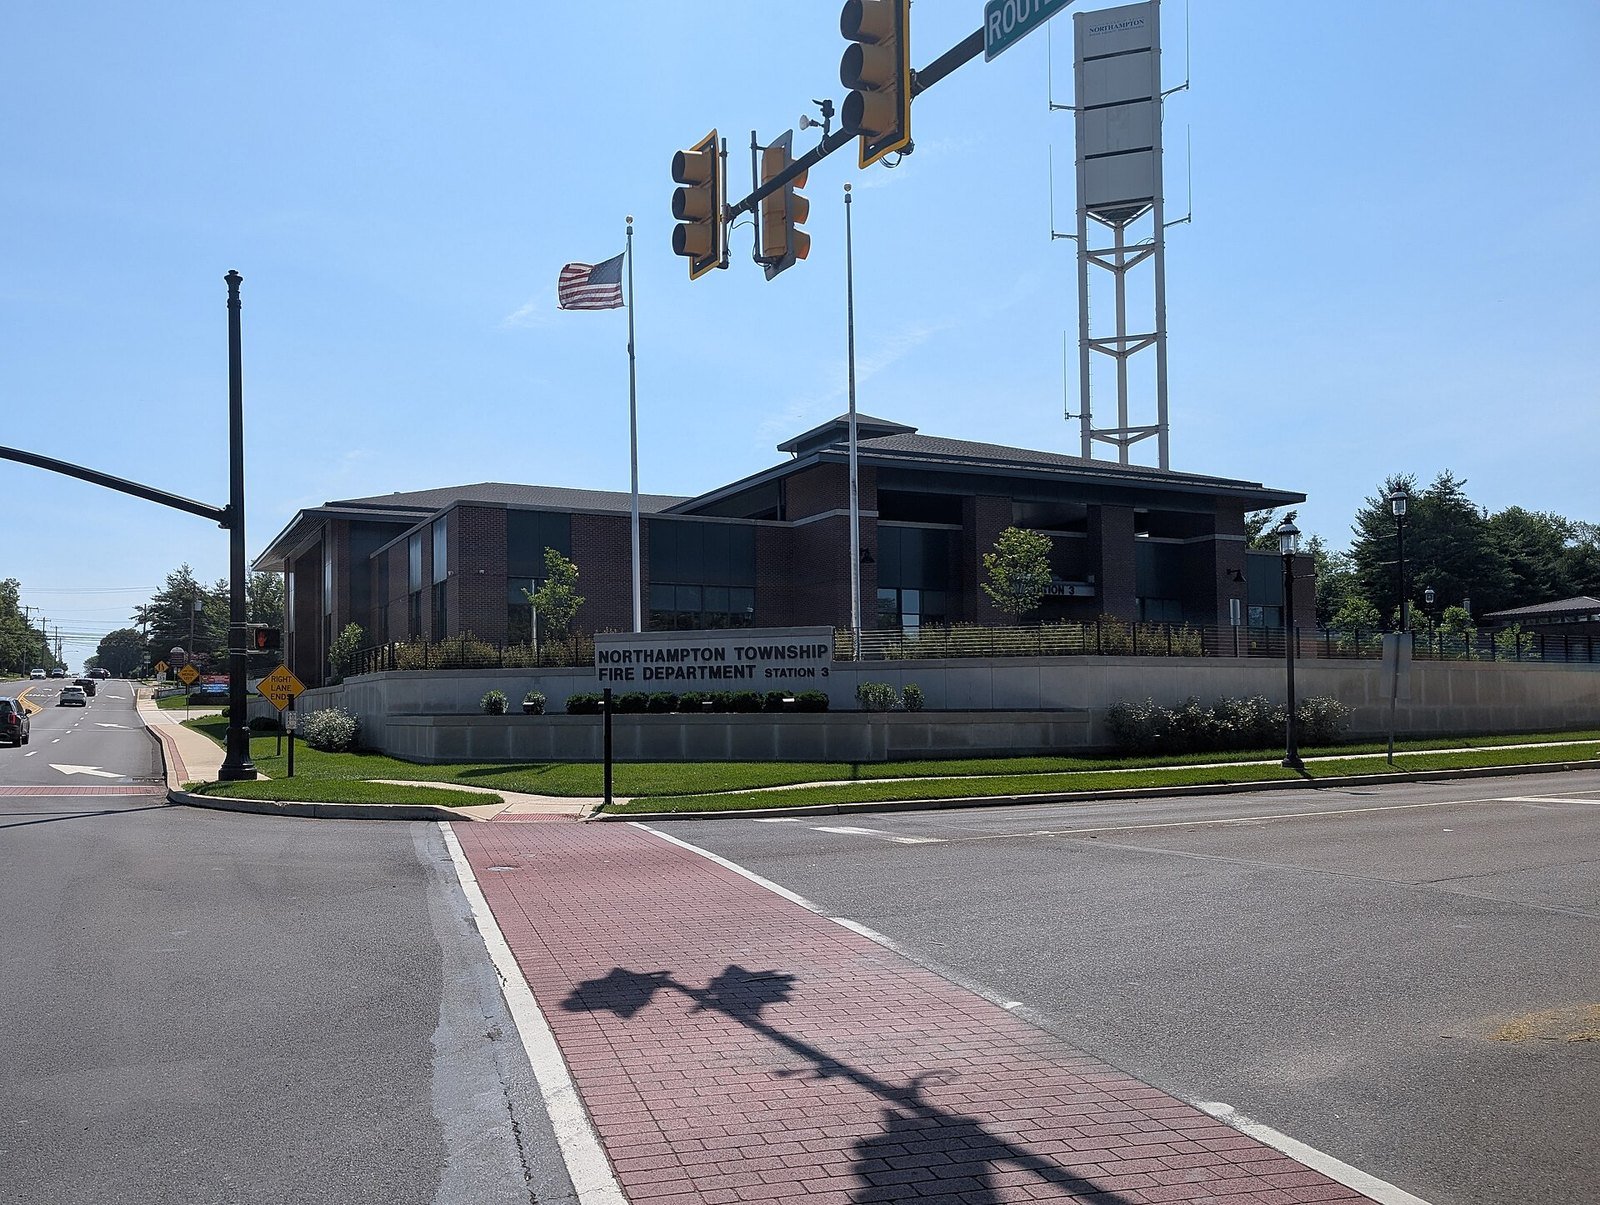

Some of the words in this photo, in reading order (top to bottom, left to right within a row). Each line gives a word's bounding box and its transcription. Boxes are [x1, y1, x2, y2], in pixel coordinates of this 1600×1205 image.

[989, 0, 1052, 47] ROU
[1089, 19, 1145, 33] NORTHAMPTON
[1069, 586, 1075, 595] 3
[598, 647, 726, 664] NORTHAMPTON
[734, 644, 828, 661] TOWNSHIP
[598, 667, 635, 681] FIRE
[643, 664, 756, 681] DEPARTMENT
[765, 667, 815, 679] STATION
[821, 667, 829, 677] 3
[270, 684, 292, 692] LANE
